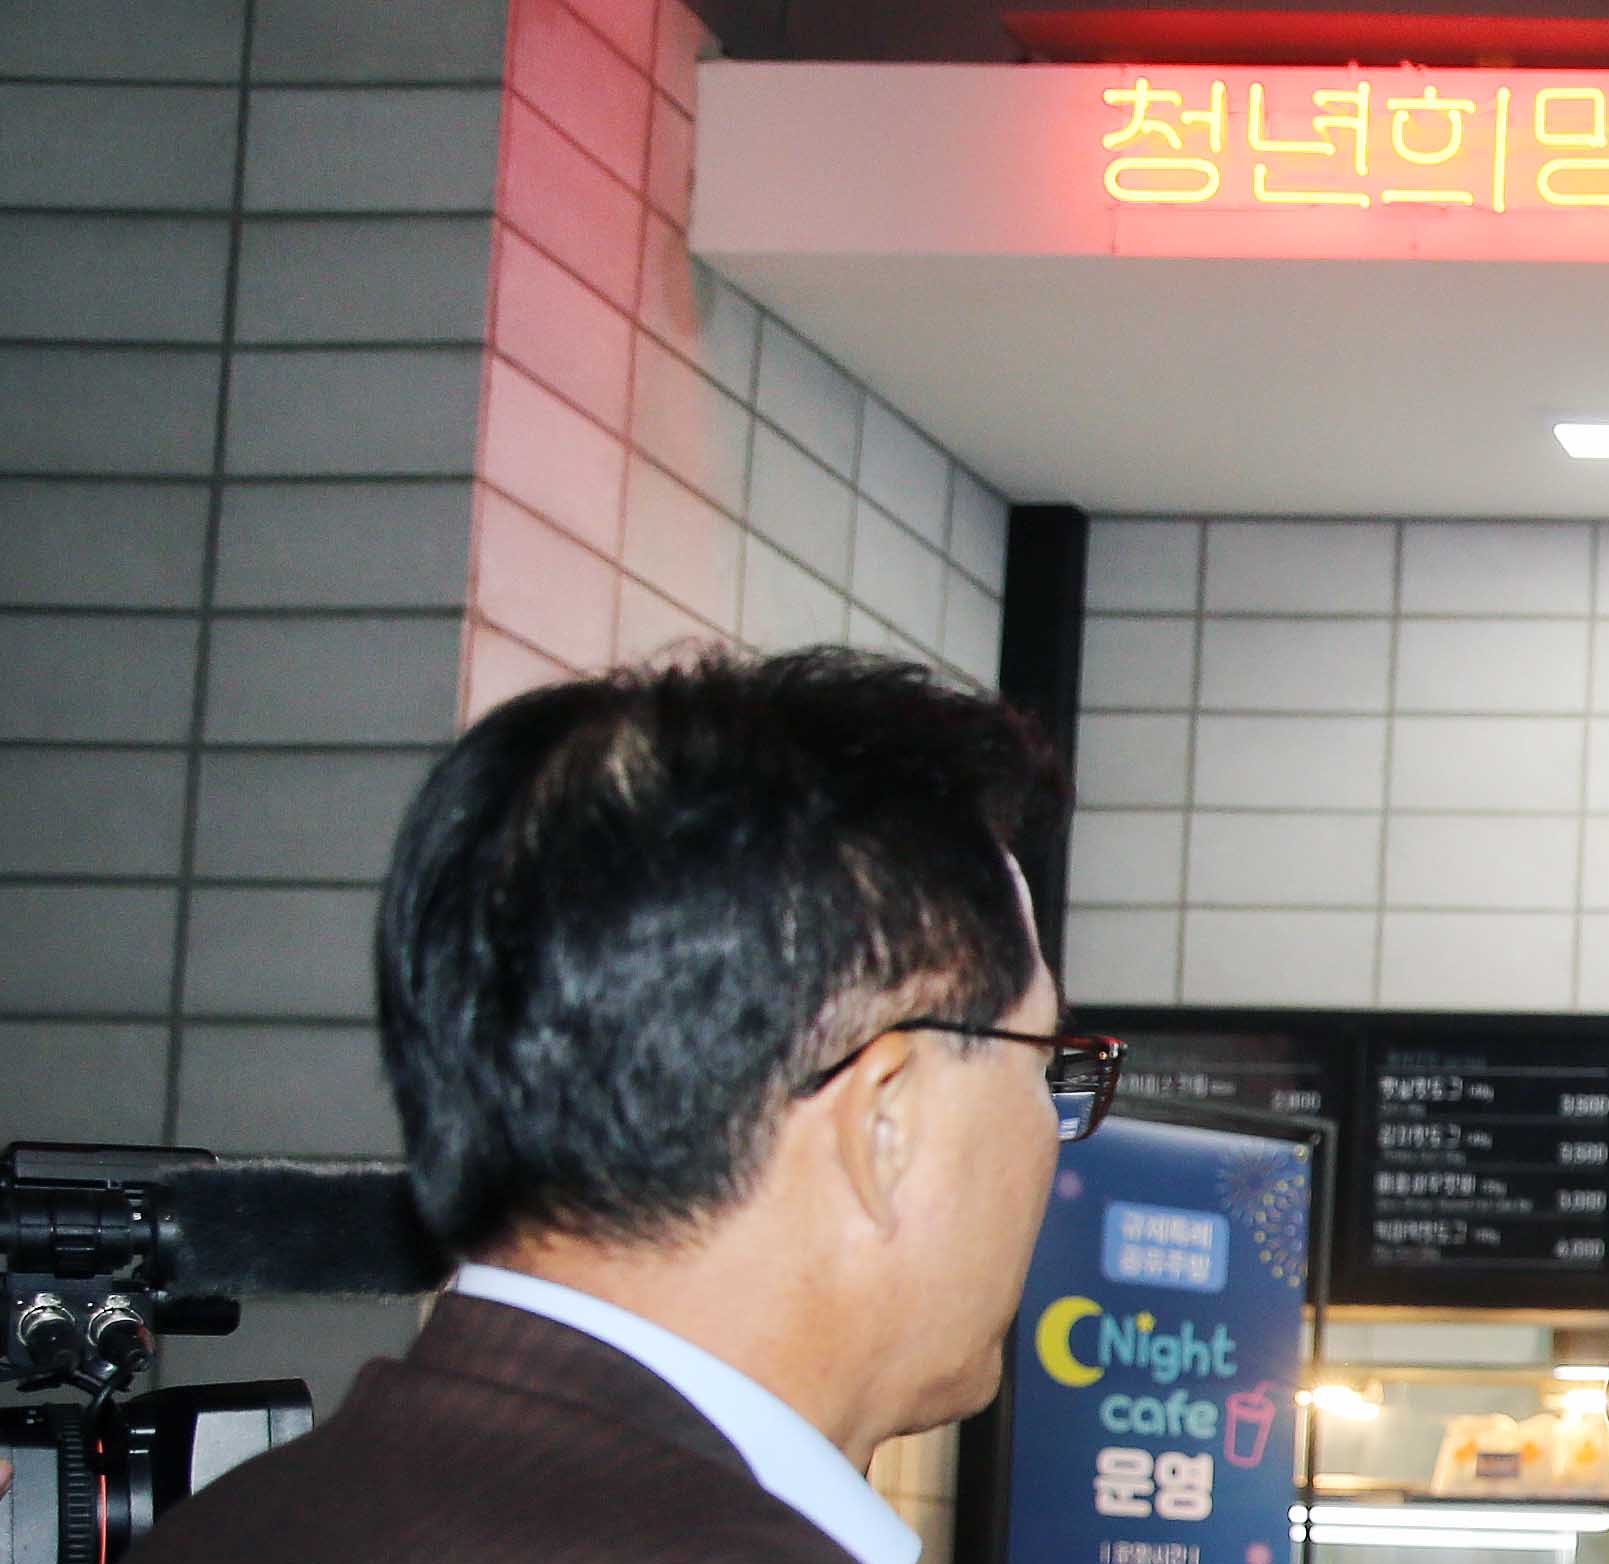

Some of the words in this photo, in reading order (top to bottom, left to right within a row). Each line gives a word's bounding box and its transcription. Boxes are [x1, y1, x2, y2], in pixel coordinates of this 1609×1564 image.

[1097, 1311, 1238, 1385] Night
[1101, 1387, 1220, 1440] cafe
[1092, 1445, 1215, 1521] 운영
